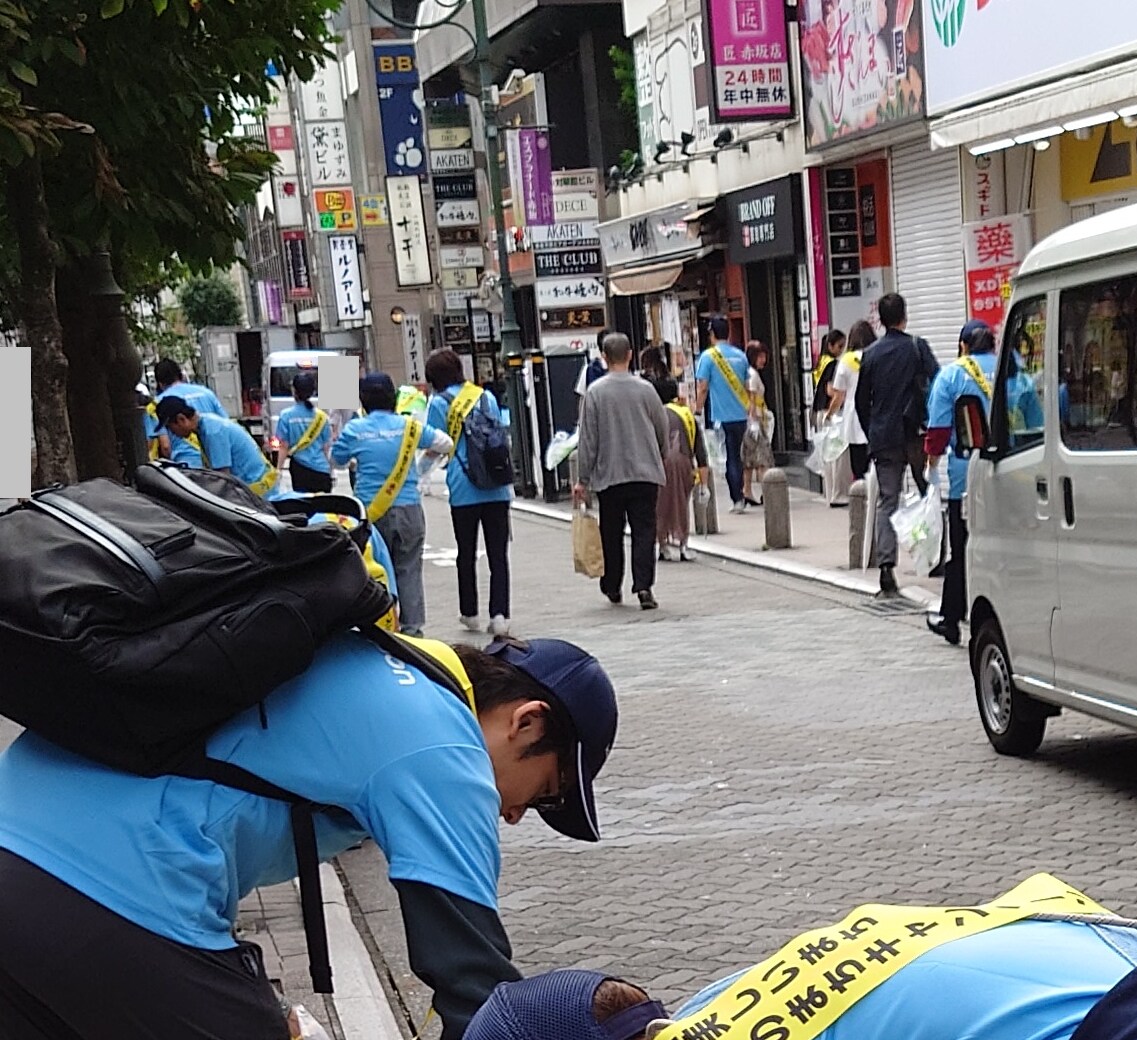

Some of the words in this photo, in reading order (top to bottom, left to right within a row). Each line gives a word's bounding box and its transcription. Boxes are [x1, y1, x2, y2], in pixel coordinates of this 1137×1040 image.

[742, 43, 782, 60] 赤坂店
[725, 68, 783, 86] 24時間
[379, 87, 394, 99] 2F
[723, 86, 788, 105] 年中無休
[436, 153, 470, 168] AKATEN
[976, 173, 991, 217] スギド
[556, 199, 588, 213] DECE
[739, 199, 762, 223] BRAND
[762, 195, 775, 217] OFF
[547, 223, 584, 239] AKATEN
[537, 253, 560, 268] THE
[563, 251, 598, 267] CLUB
[338, 253, 358, 315] ルノアール
